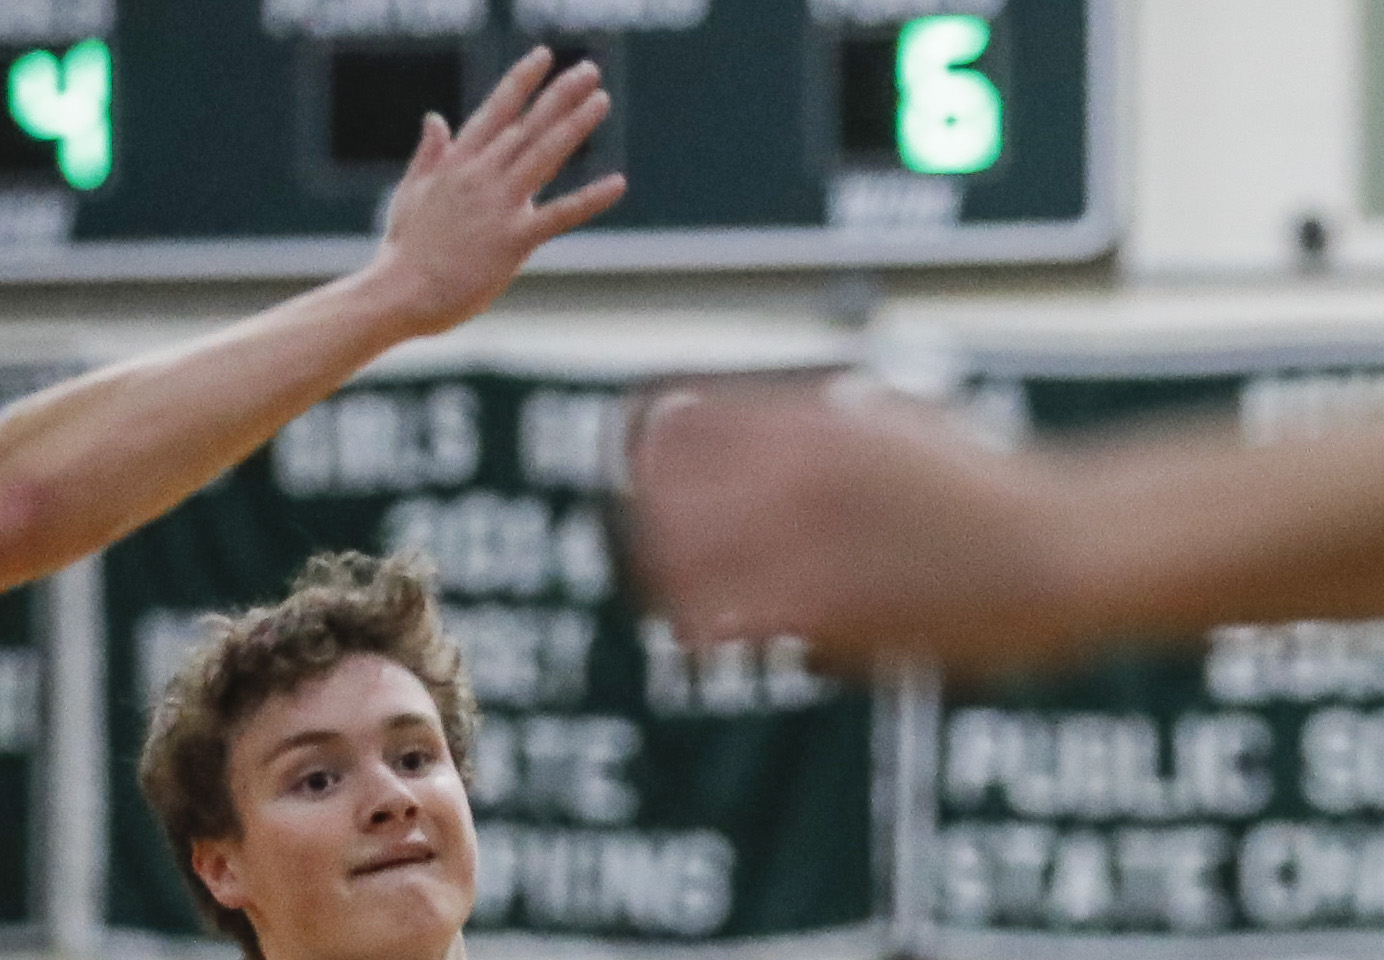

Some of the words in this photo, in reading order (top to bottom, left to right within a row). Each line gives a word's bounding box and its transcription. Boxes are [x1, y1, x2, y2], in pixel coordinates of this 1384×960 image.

[9, 38, 112, 190] 4
[897, 15, 1003, 175] 6
[946, 708, 1272, 818] PUBLIC
[934, 822, 1228, 930] STATE
